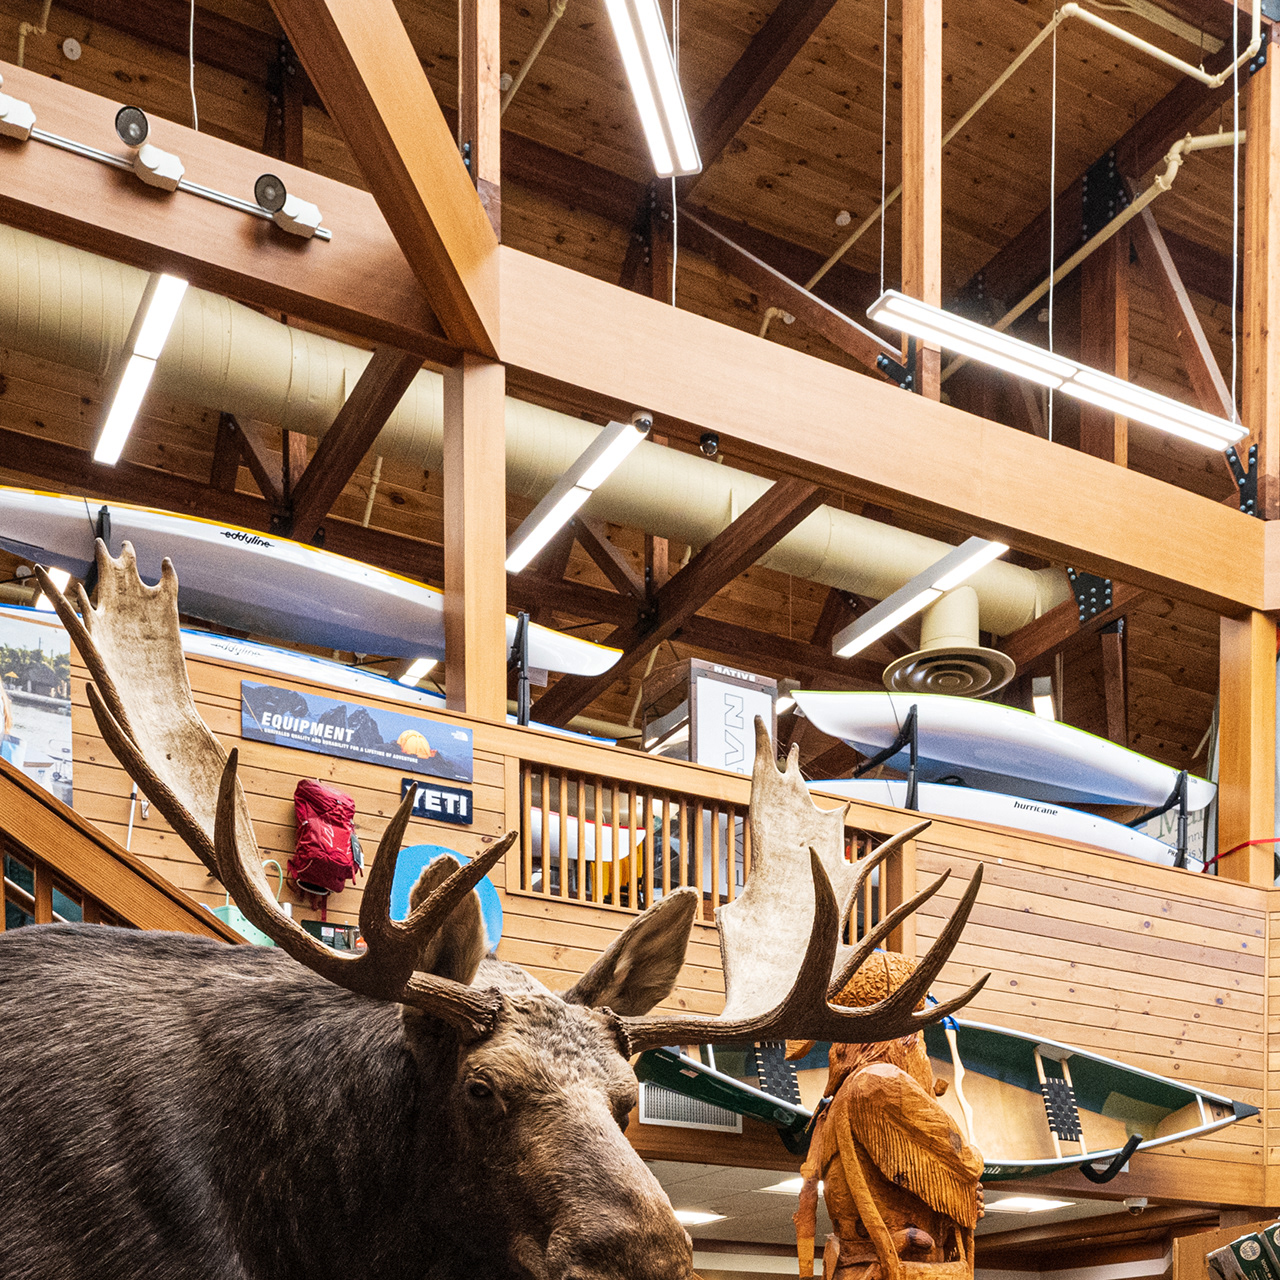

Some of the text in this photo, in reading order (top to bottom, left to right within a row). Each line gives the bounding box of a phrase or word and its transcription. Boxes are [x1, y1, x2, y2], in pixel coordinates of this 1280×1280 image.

[220, 531, 275, 548] eddyline
[713, 665, 756, 682] NATIVE
[261, 711, 355, 742] EQUIPMENT
[291, 733, 311, 742] QUALITY
[311, 736, 321, 744] AND
[364, 748, 385, 757] LIFETIME
[392, 753, 419, 764] ADVENTURE
[405, 785, 469, 816] YETI
[1013, 800, 1058, 816] hurricane
